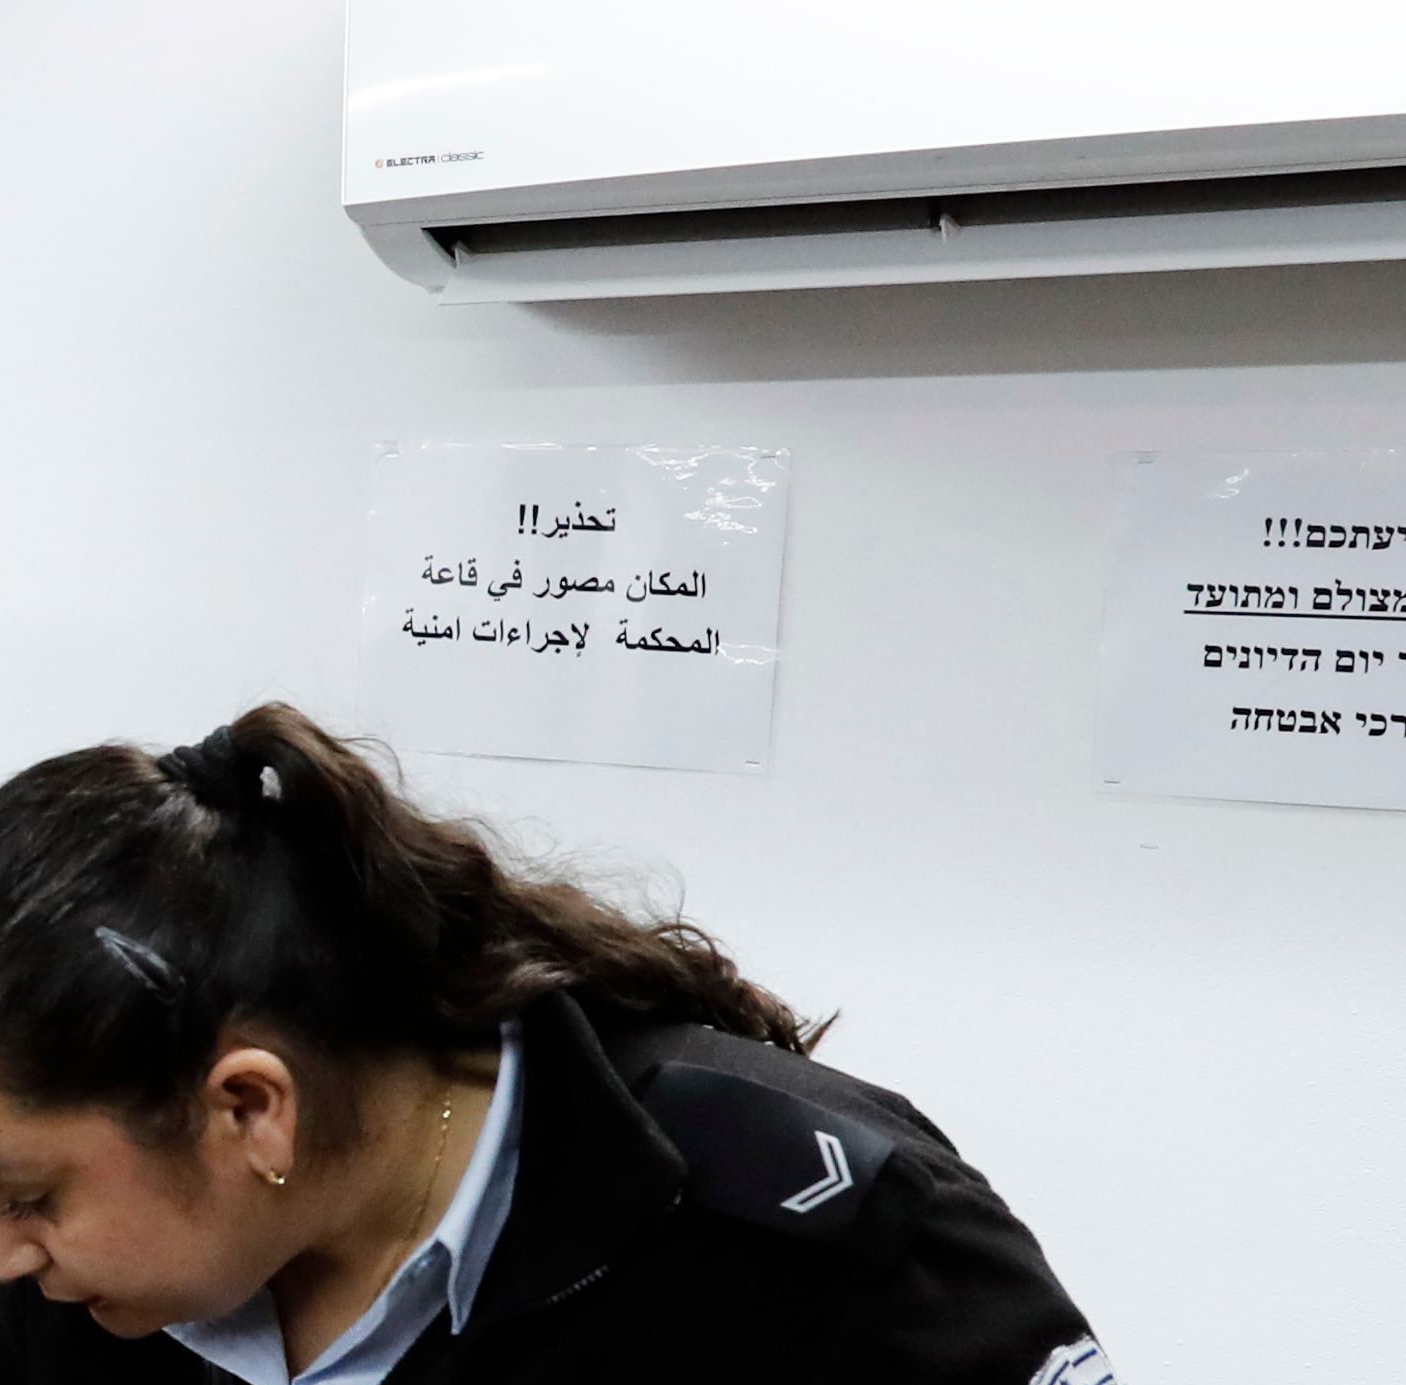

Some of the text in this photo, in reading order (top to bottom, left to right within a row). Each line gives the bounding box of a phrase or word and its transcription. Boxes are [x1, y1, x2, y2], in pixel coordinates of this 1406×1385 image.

[386, 150, 485, 168] ELECTRA classic
[517, 500, 617, 539] تحذير!!
[420, 555, 707, 602] المكان مصور في قاعة
[1186, 583, 1299, 610] ומתועד
[401, 607, 719, 658] المحكمة لإجراءات امنية
[1203, 643, 1385, 675] יום הדיונים
[1230, 706, 1343, 735] אבטחה
